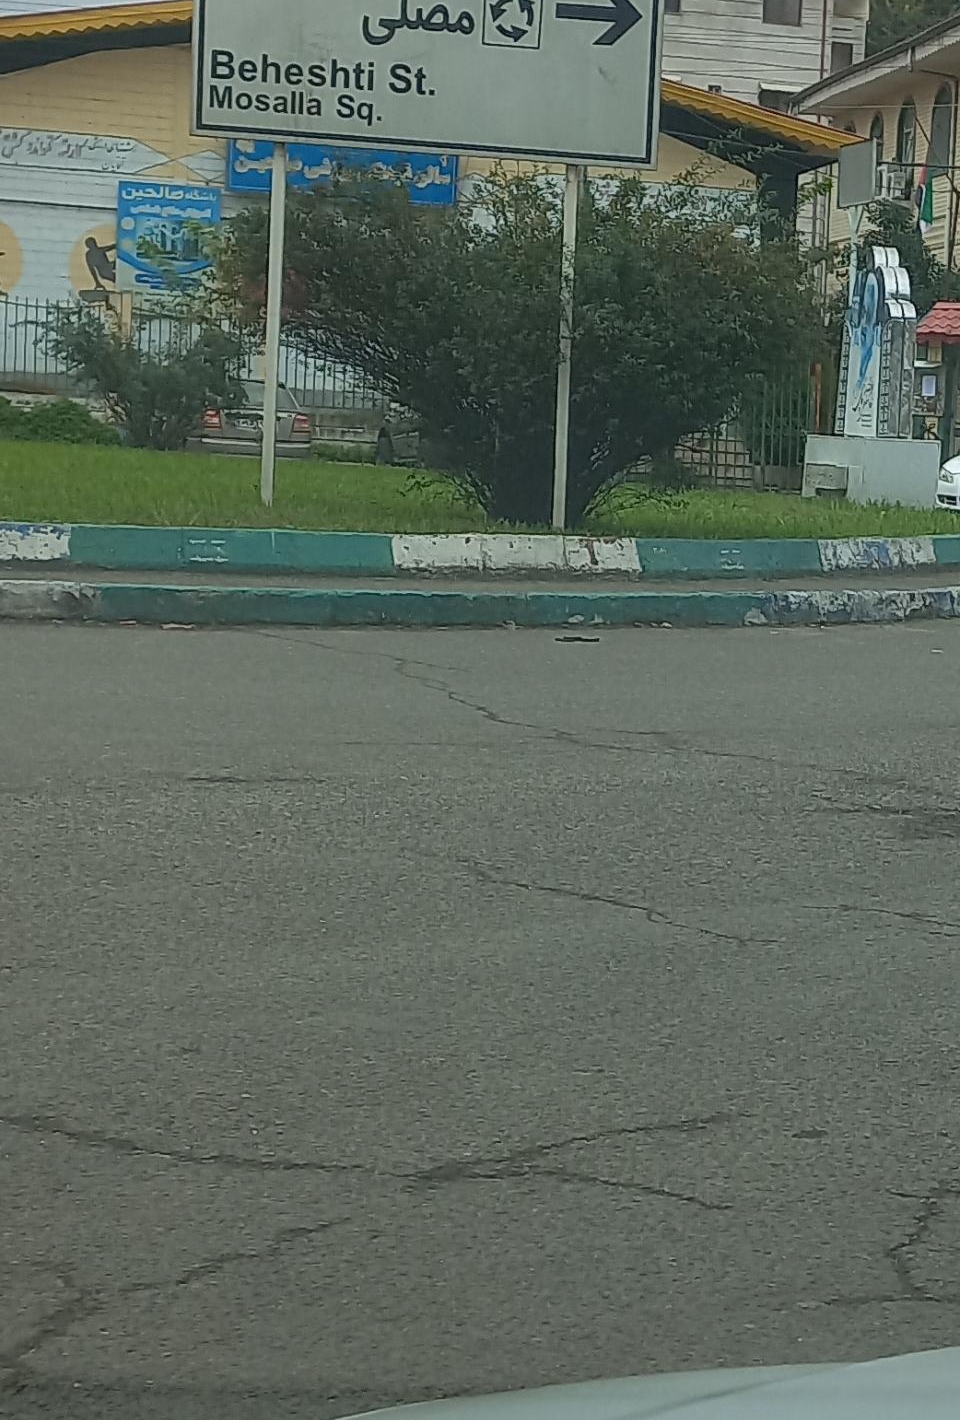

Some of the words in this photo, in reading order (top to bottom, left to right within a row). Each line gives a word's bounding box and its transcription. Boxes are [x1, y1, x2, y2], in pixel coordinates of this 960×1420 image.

[210, 49, 374, 92] Beheshti
[389, 63, 437, 96] St.
[209, 84, 322, 117] Mosalla
[336, 94, 383, 127] Sq.
[121, 186, 184, 200] صالحین
